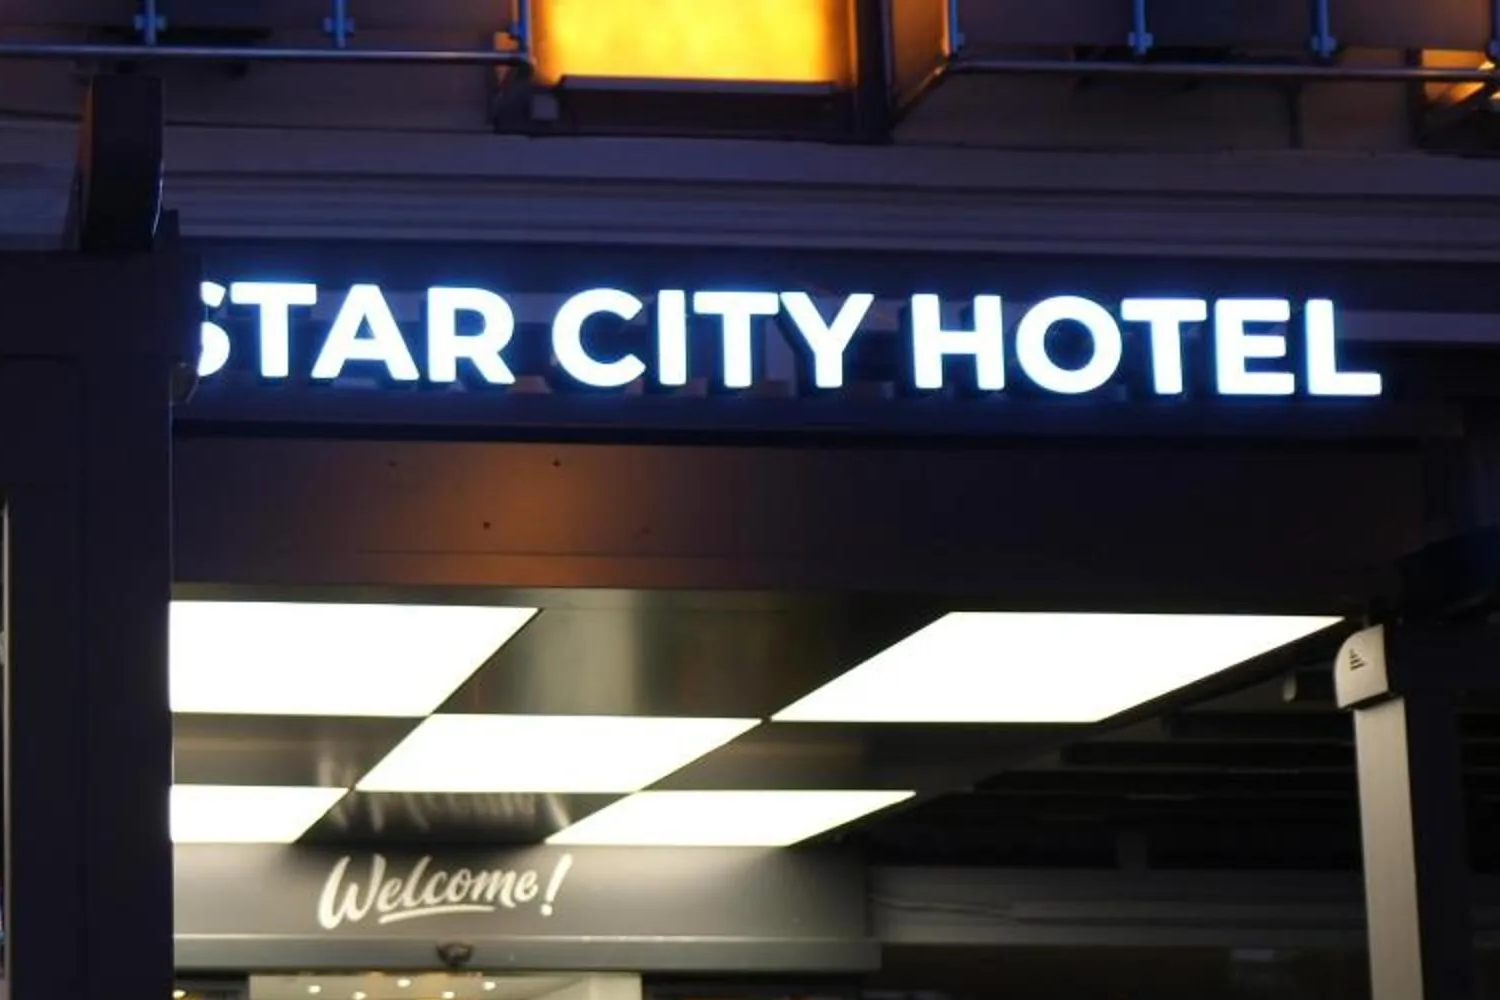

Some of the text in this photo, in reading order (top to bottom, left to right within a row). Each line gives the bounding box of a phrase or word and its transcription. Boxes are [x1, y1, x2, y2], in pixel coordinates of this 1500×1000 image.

[551, 287, 874, 388] CITY
[910, 292, 1382, 396] HOTEL
[316, 853, 574, 930] Welcome!
